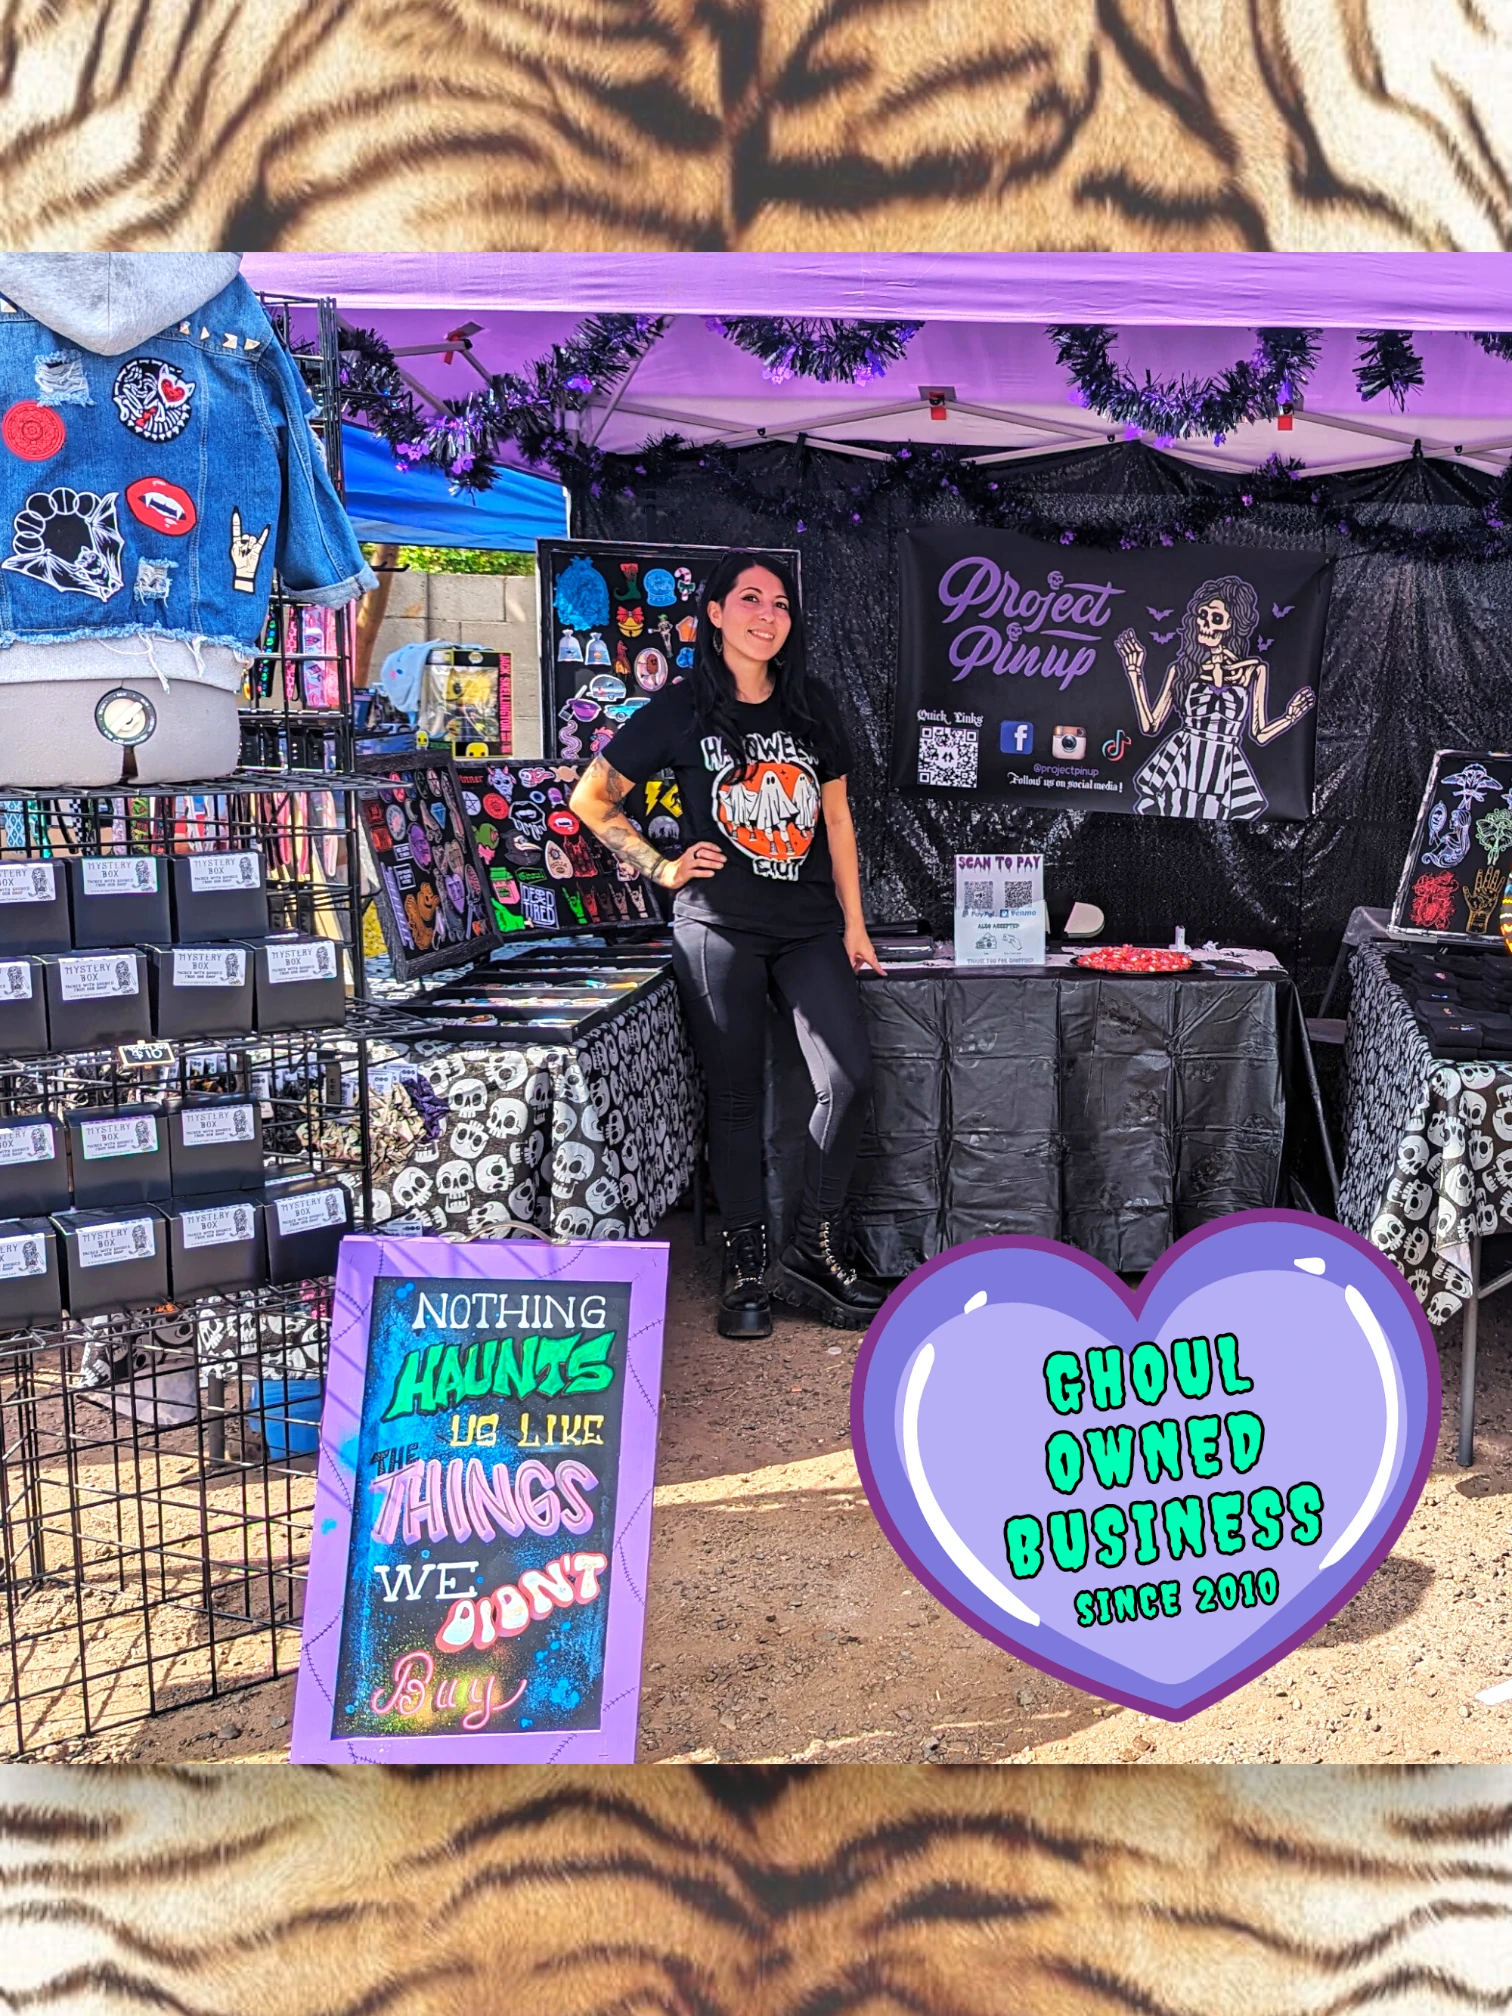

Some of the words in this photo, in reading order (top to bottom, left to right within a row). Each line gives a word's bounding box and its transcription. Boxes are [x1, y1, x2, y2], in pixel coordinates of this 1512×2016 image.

[938, 556, 1125, 632] Project
[949, 622, 1097, 691] Pinup
[917, 709, 952, 725] Quick
[954, 711, 984, 727] Links
[1033, 763, 1099, 777] @projectpinup
[1007, 771, 1041, 787] Follow
[1044, 777, 1055, 788] us
[1056, 780, 1066, 788] on
[1067, 778, 1093, 790] social
[87, 861, 132, 870] MYSTERY
[193, 858, 236, 868] MYSTERY
[958, 856, 991, 873] SCAN
[995, 856, 1013, 873] TO
[1017, 856, 1041, 873] PAY
[101, 870, 119, 878] BOX
[208, 867, 225, 875] BOX
[971, 910, 995, 918] PayPal
[178, 953, 222, 962] MYSTERY
[271, 948, 313, 959] MYSTERY
[192, 962, 209, 970] BOX
[285, 958, 302, 966] BOX
[64, 963, 111, 975] MYSTERY
[80, 973, 99, 982] BOX
[186, 1111, 230, 1122] MYSTERY
[86, 1123, 131, 1135] MYSTERY
[200, 1121, 217, 1129] BOX
[101, 1132, 119, 1141] BOX
[281, 1197, 322, 1211] MYSTERY
[187, 1211, 230, 1224] MYSTERY
[295, 1207, 311, 1217] BOX
[201, 1221, 218, 1230] BOX
[82, 1228, 129, 1242] MYSTERY
[98, 1238, 116, 1248] BOX
[412, 1291, 607, 1330] NOTHING
[381, 1330, 617, 1421] HAUNTS
[450, 1414, 497, 1448] US
[517, 1413, 605, 1447] LIKE
[370, 1442, 418, 1479] THE
[370, 1457, 600, 1546] THINGS
[374, 1560, 481, 1602] WE
[436, 1551, 608, 1652] DIDN'T
[371, 1650, 528, 1731] Buy
